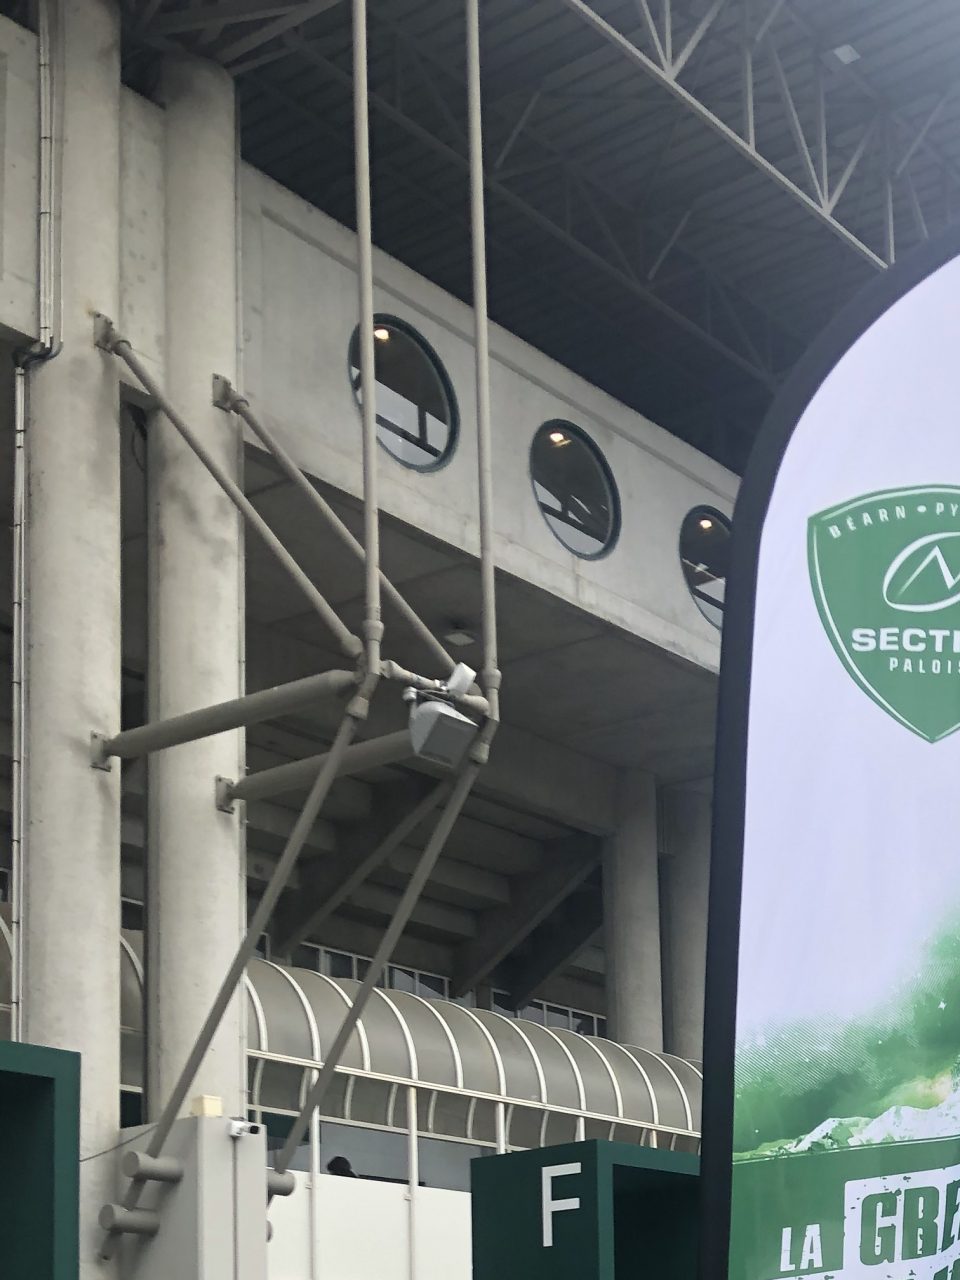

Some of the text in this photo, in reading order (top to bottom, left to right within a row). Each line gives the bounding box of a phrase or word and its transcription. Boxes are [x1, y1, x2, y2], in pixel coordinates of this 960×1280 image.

[828, 504, 907, 540] BÉARN
[541, 1162, 582, 1247] F
[780, 1223, 824, 1272] LA
